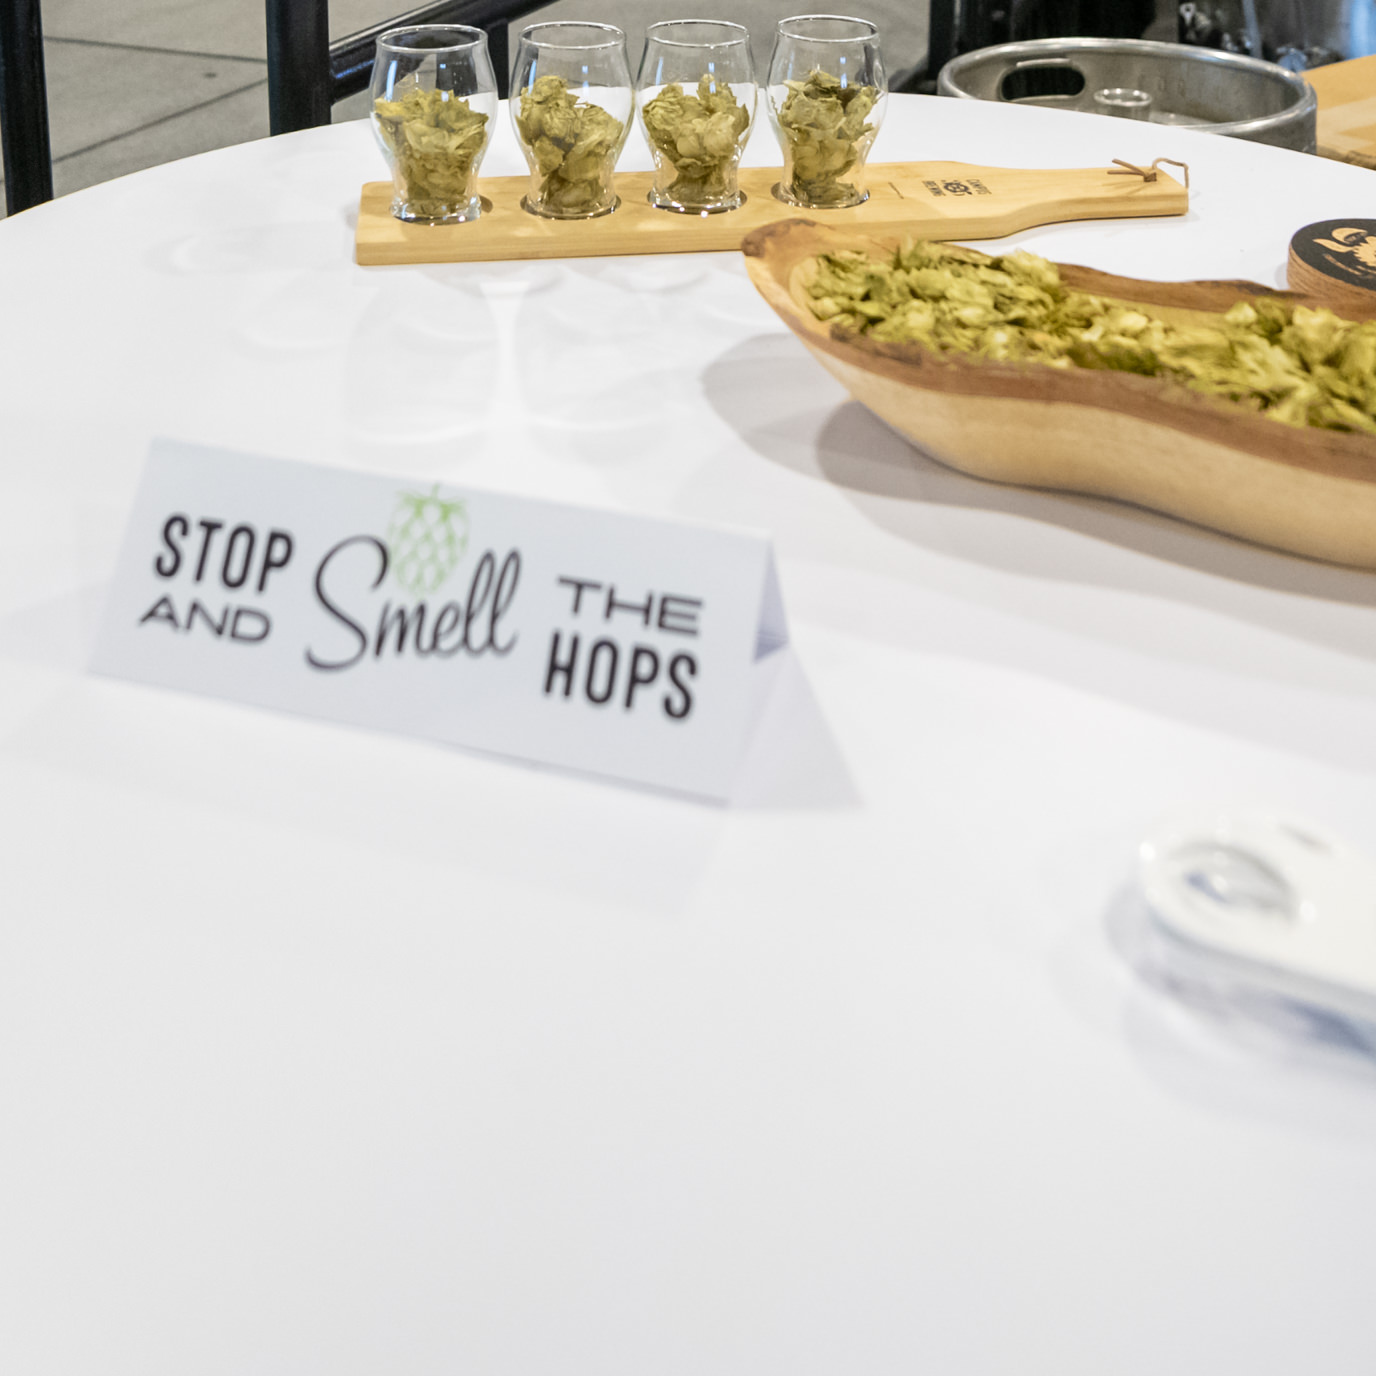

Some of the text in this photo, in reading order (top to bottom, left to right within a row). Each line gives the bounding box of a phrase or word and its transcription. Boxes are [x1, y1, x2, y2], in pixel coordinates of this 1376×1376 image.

[155, 513, 294, 594] STOP
[139, 594, 272, 644] AND
[304, 534, 522, 673] Smell
[557, 575, 704, 637] THE
[543, 629, 698, 721] HOPS
